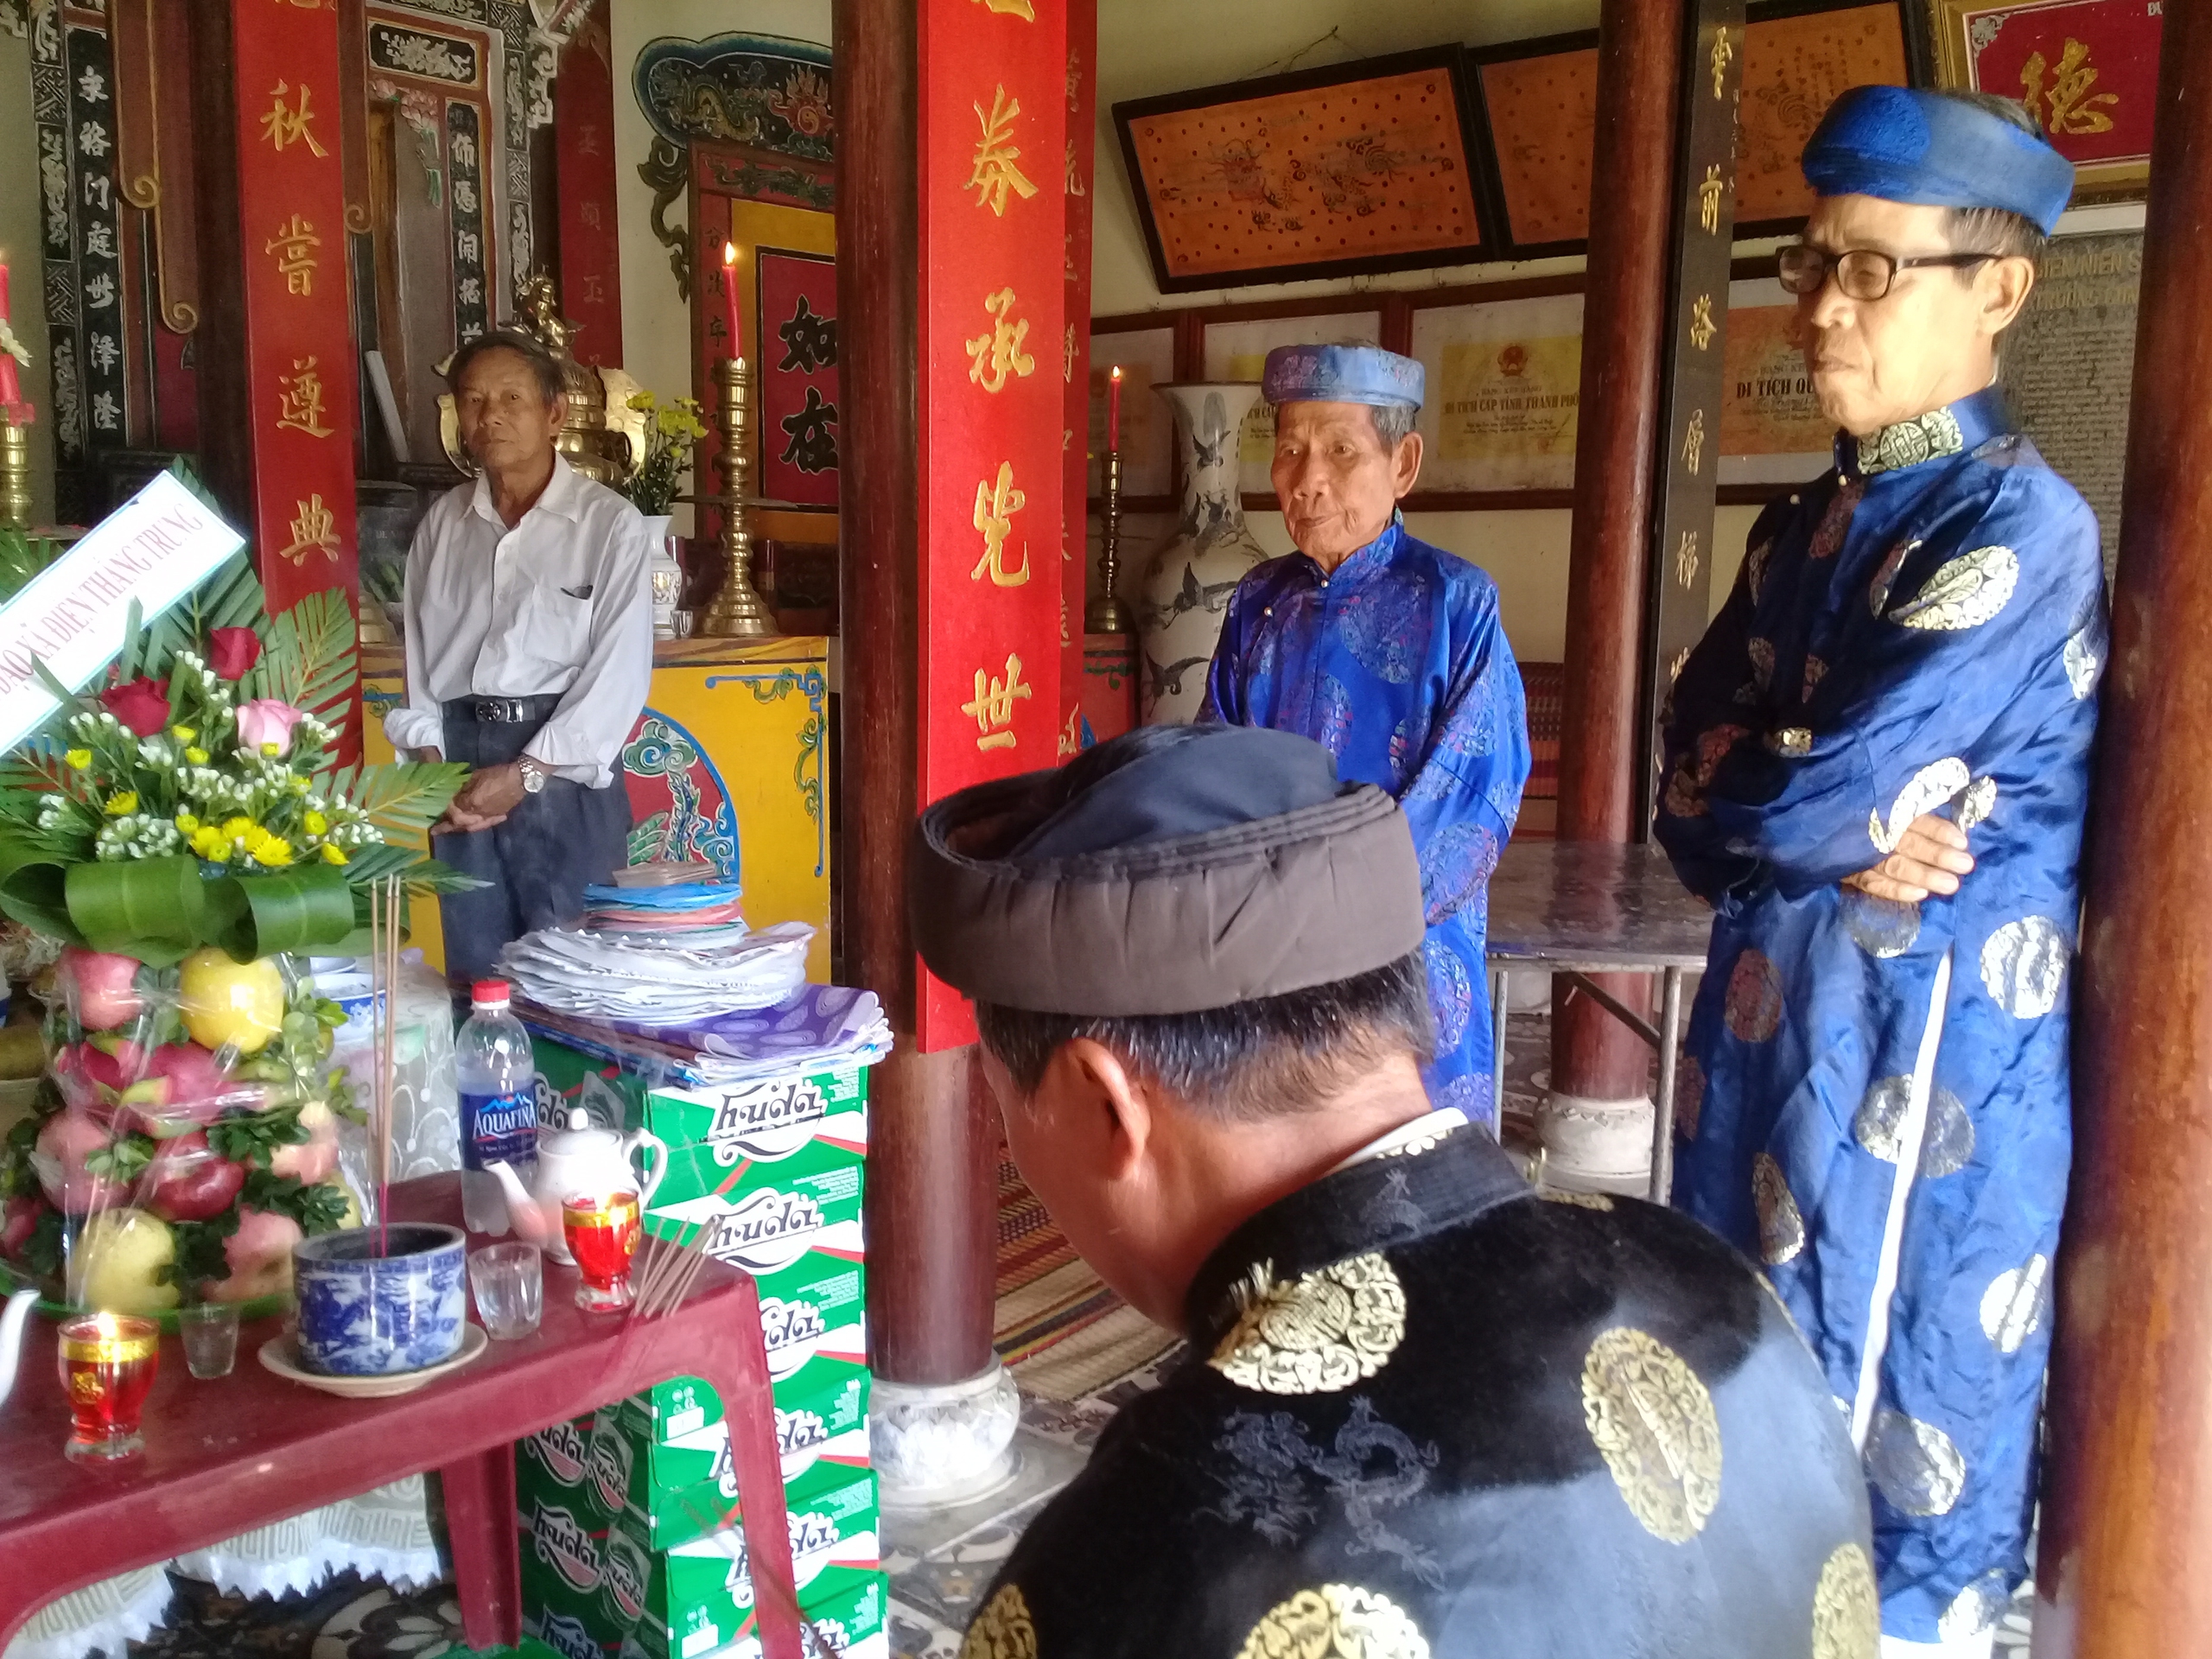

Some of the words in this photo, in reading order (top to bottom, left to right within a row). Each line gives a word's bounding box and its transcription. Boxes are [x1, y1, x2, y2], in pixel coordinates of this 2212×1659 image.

[473, 1103, 537, 1140] AQUAFINA
[715, 1081, 824, 1133] huda
[713, 1195, 820, 1250] huda
